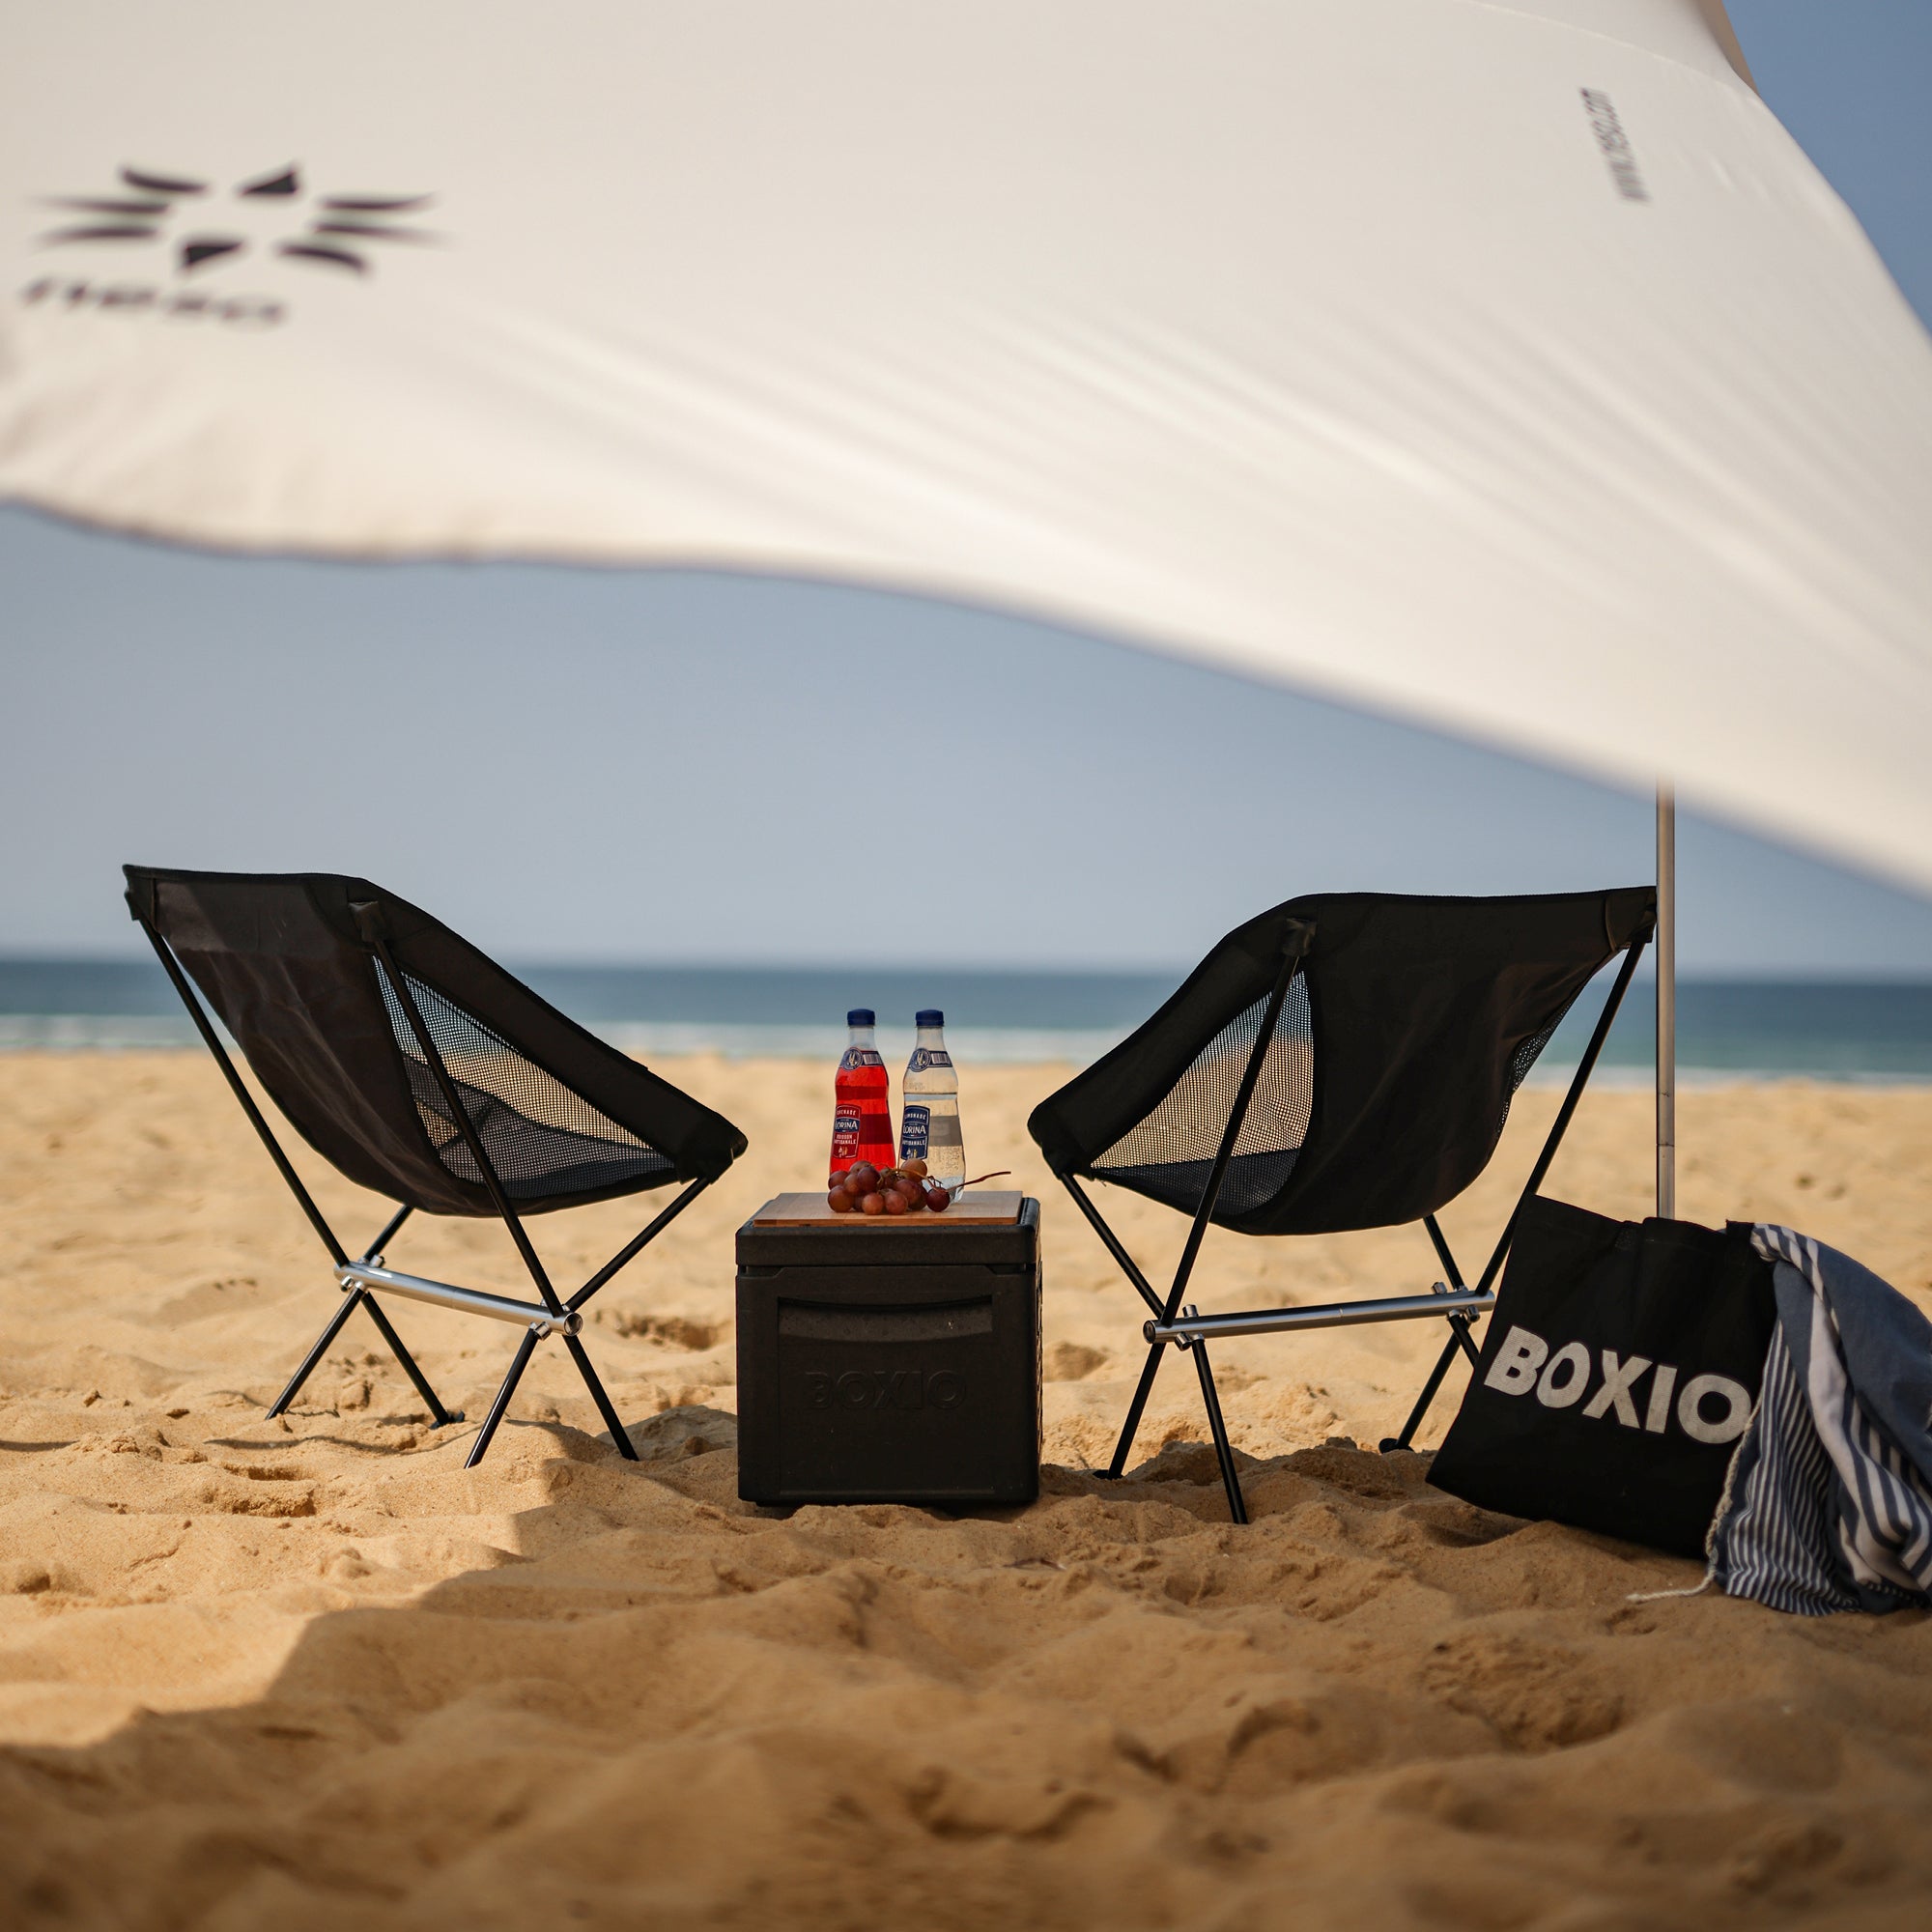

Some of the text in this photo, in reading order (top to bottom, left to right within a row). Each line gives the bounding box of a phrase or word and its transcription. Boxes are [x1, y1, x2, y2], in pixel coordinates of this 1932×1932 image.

[902, 1124, 926, 1134] LORINA
[805, 1368, 966, 1410] BOXIO
[1484, 1324, 1751, 1444] BOXIO
